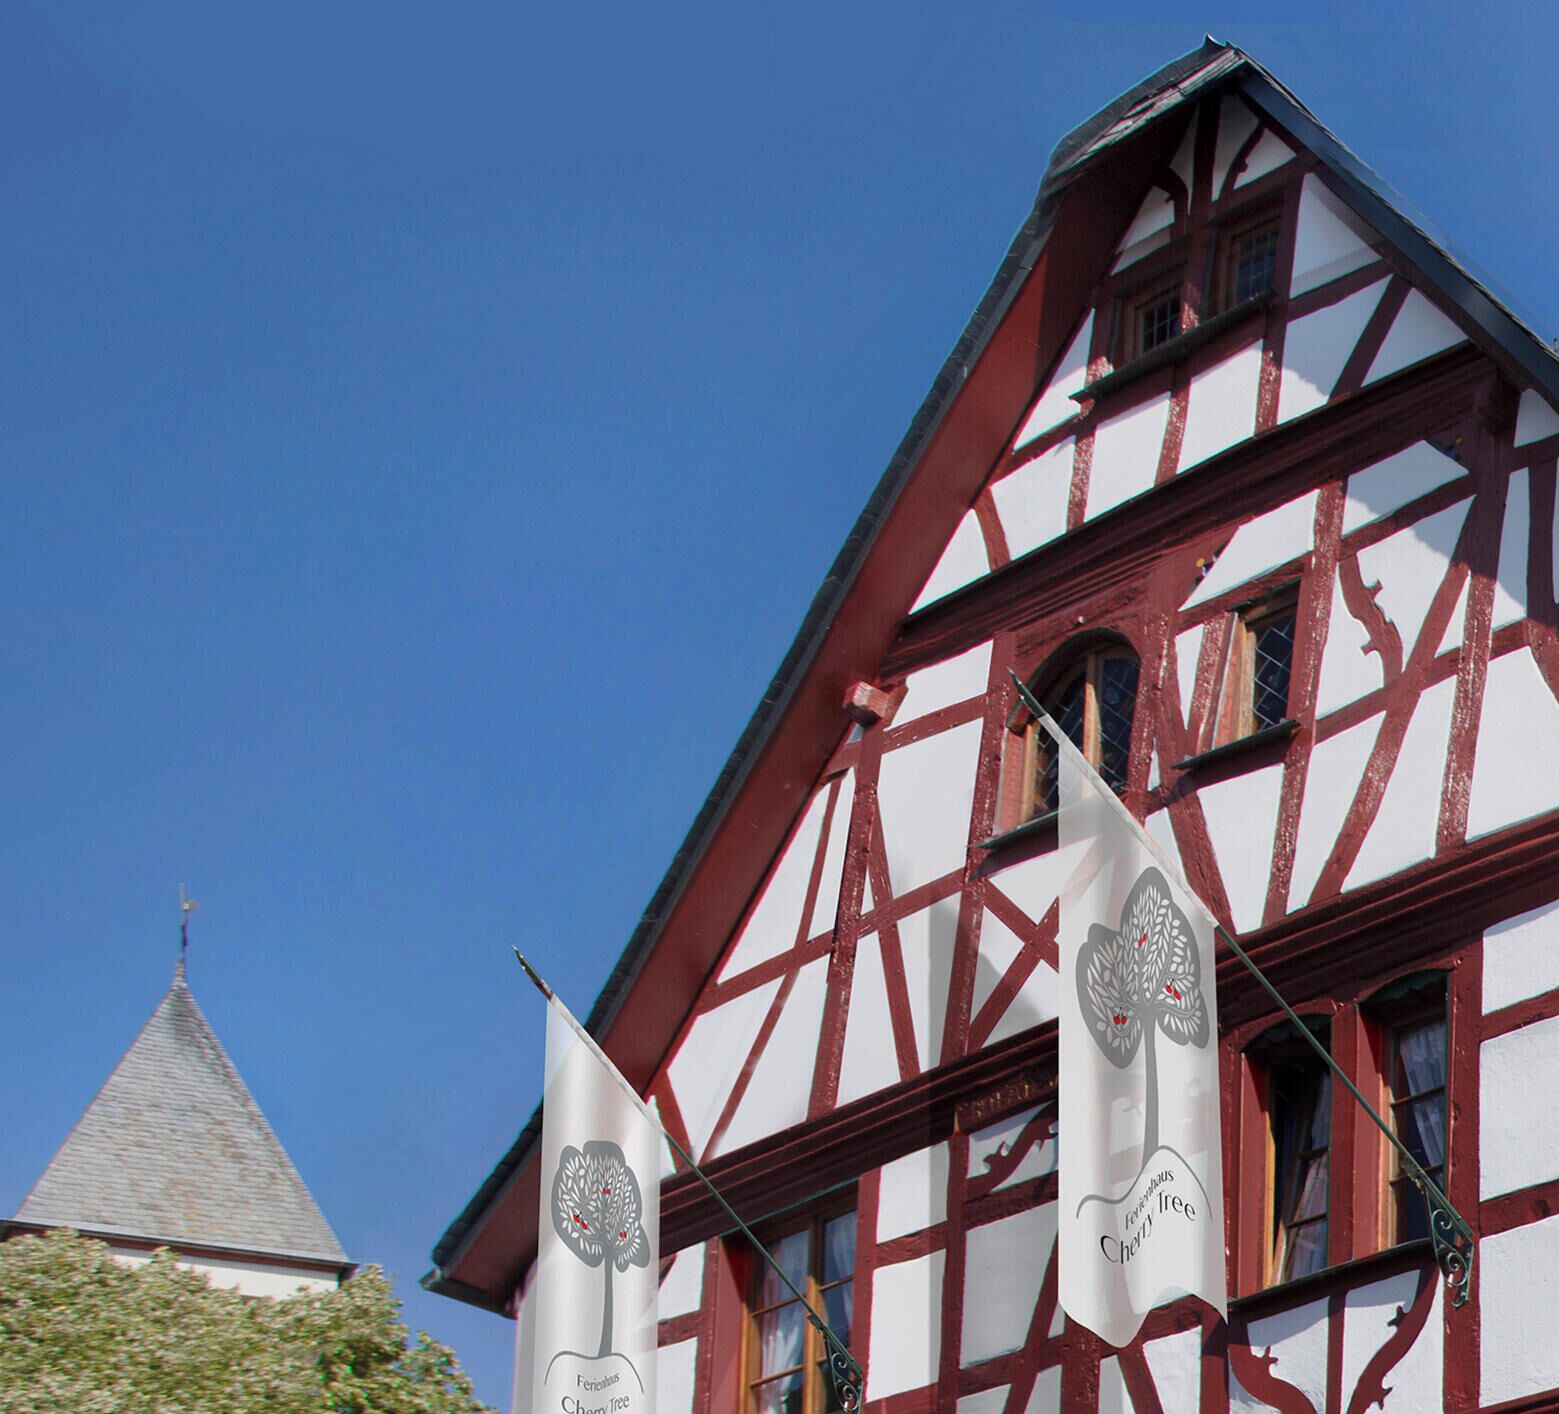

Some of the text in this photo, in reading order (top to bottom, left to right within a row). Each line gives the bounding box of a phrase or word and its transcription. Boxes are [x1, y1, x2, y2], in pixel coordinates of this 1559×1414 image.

[1125, 1169, 1174, 1230] Ferienhaus
[1100, 1189, 1195, 1264] Cherry Tree
[577, 1373, 620, 1392] Ferienhaus
[609, 1395, 630, 1414] Tree
